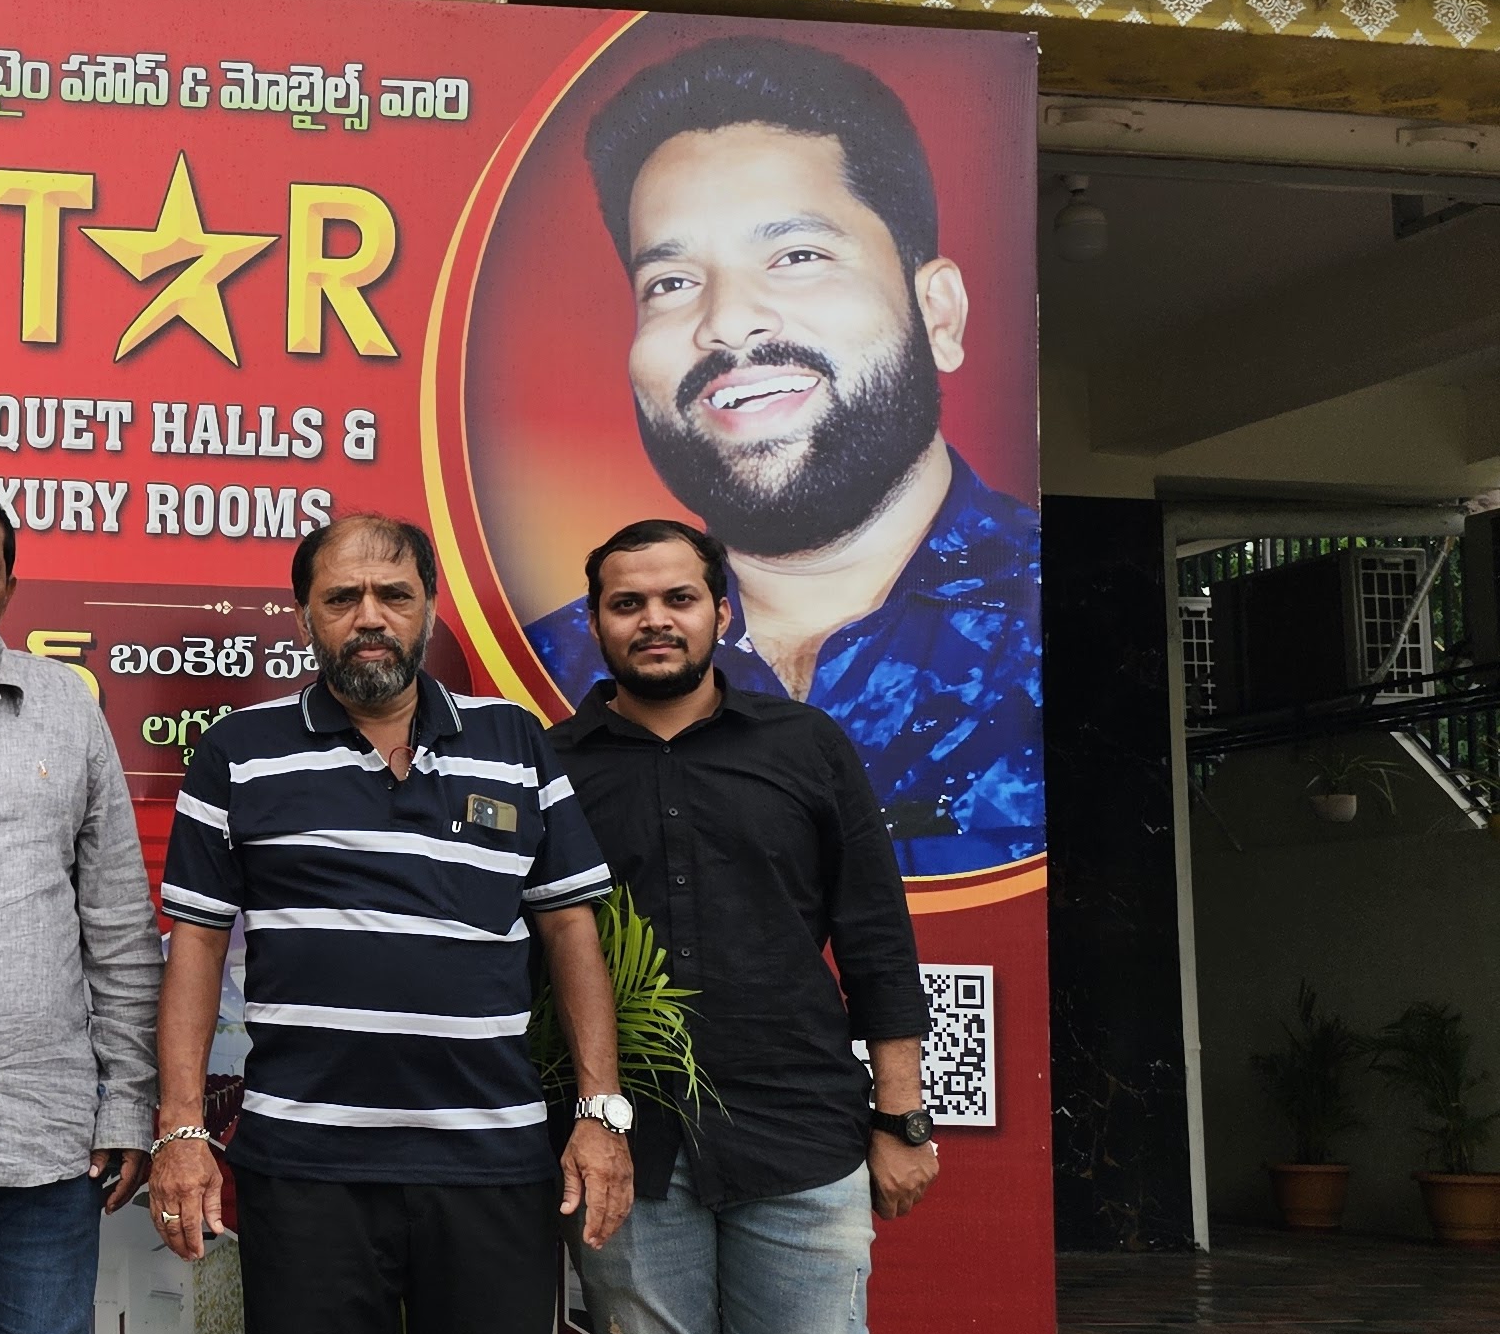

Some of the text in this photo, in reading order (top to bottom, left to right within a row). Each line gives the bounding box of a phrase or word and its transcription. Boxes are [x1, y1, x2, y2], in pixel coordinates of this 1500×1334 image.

[60, 53, 169, 106] హౌస్
[179, 66, 211, 108] &
[219, 61, 369, 130] మోబైల్స్
[380, 77, 470, 121] వారి
[151, 402, 324, 460] HALLS
[343, 408, 377, 461] &
[145, 481, 332, 539] ROOMS
[110, 635, 257, 678] బంకెట్
